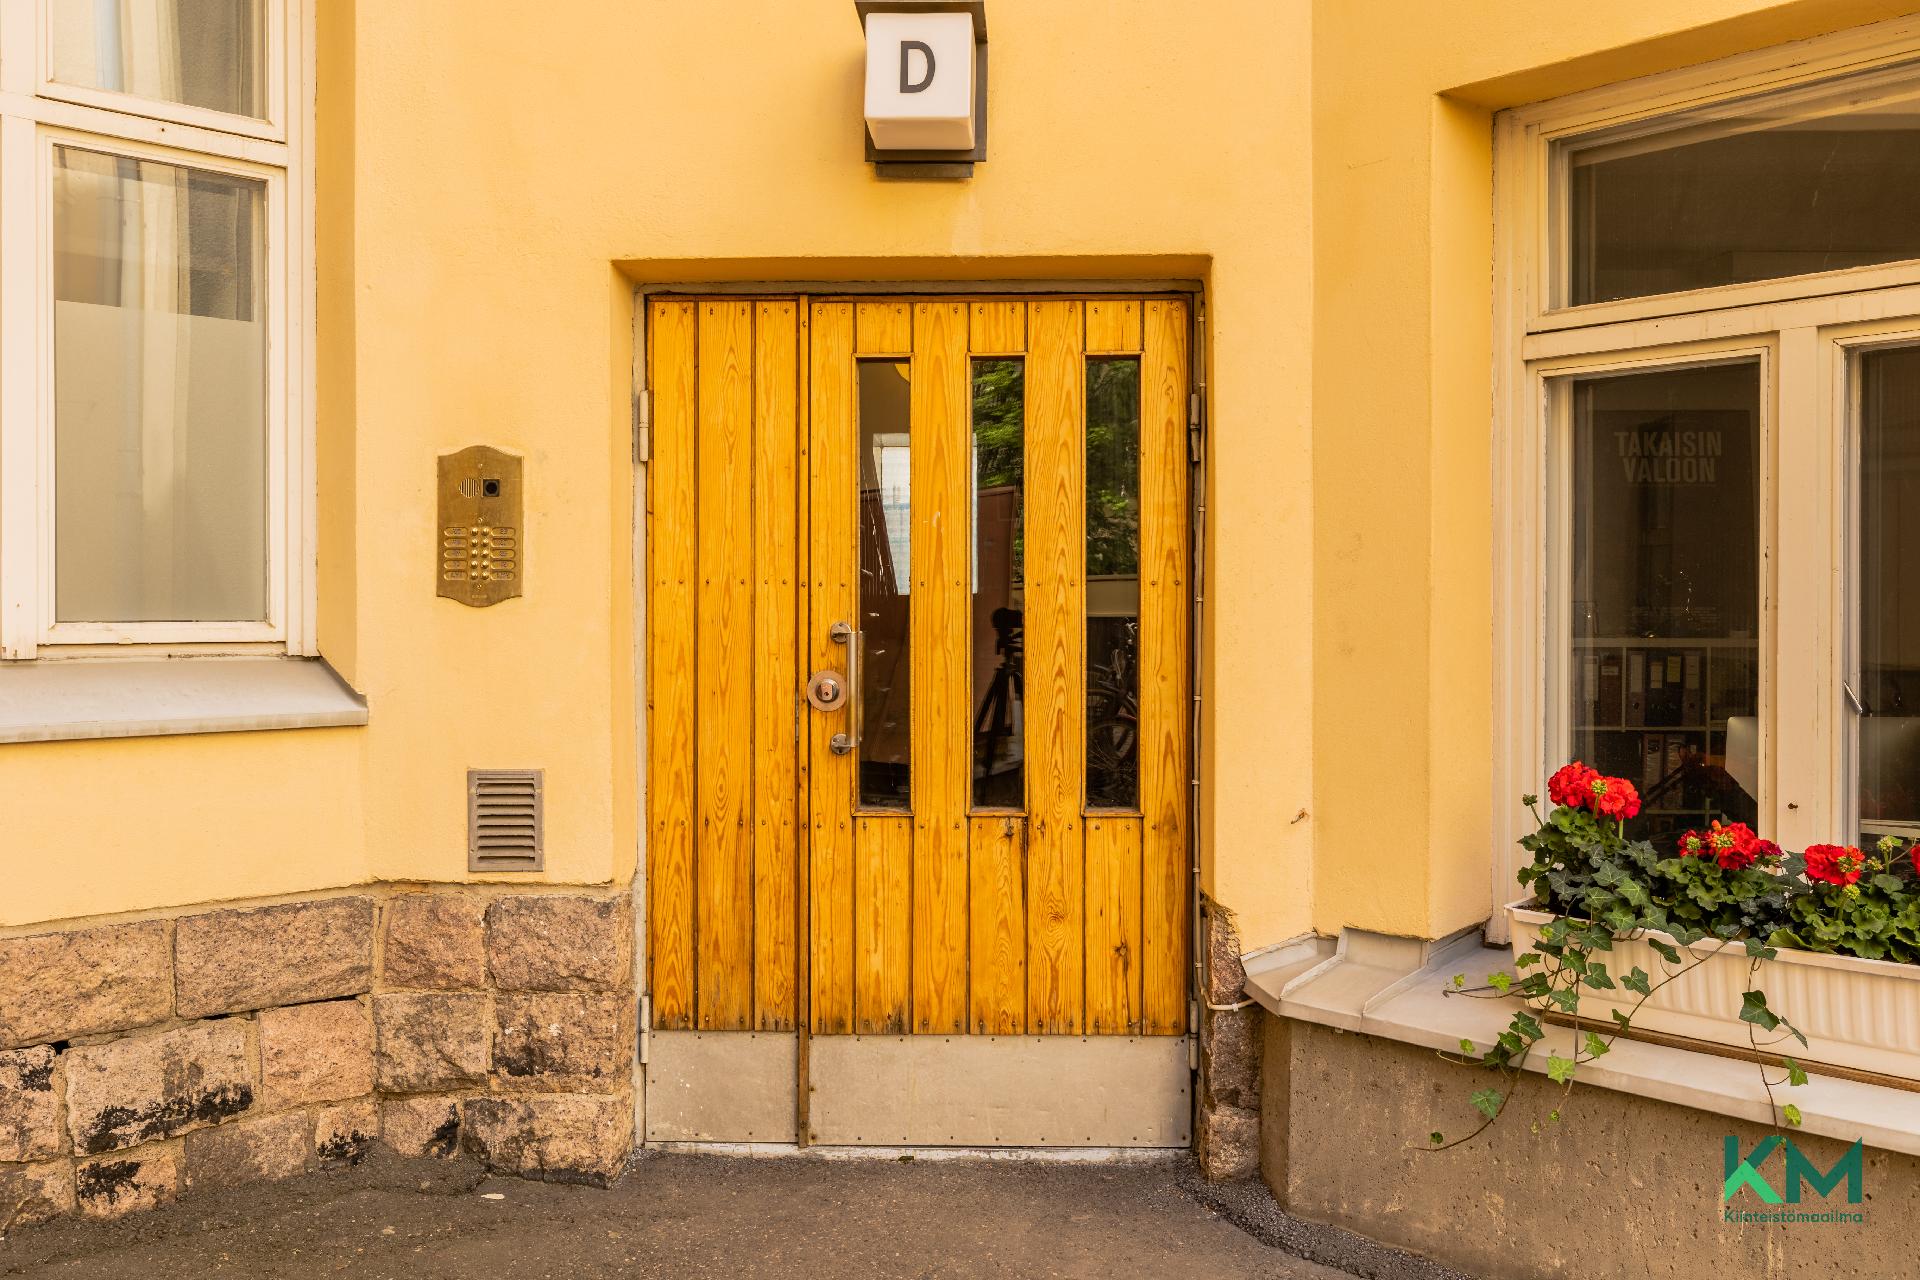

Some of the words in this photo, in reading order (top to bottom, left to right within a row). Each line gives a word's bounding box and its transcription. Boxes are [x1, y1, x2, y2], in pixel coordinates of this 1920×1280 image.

[899, 40, 936, 94] D
[1613, 431, 1722, 457] TAKAISIN
[1622, 457, 1716, 482] VALOON
